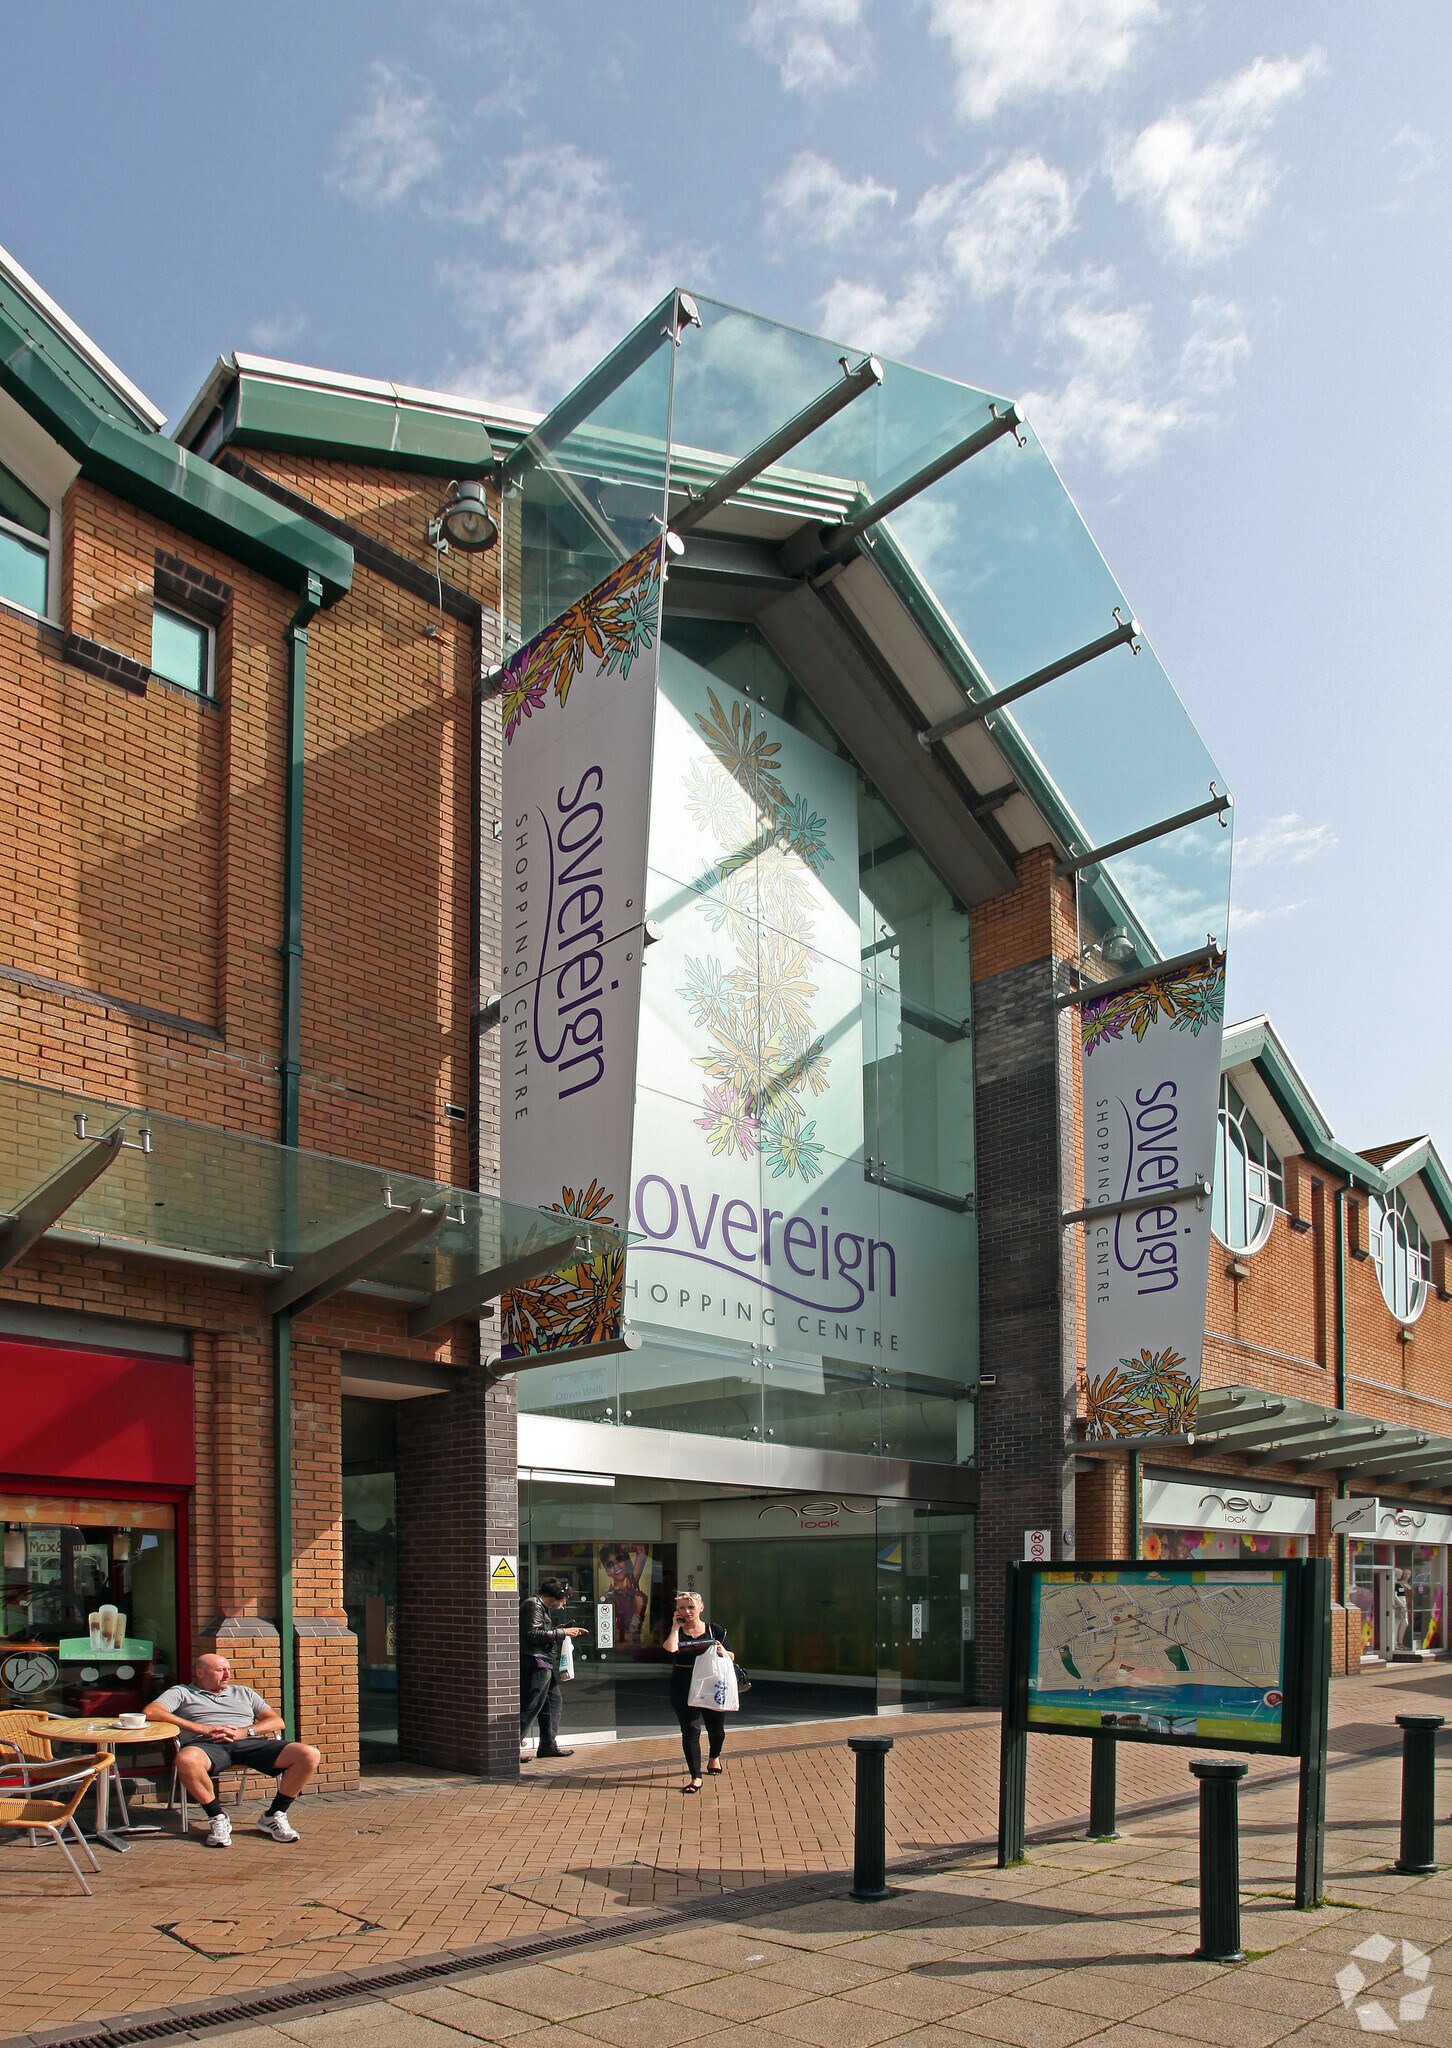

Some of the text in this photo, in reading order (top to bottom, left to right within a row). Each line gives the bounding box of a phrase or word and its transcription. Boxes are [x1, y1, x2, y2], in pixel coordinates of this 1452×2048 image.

[513, 812, 529, 1120] SHOPPING CENTRE
[534, 765, 618, 1100] sovereign
[1096, 1099, 1110, 1303] SHOPPING CENTRE
[628, 1174, 897, 1313] overeign
[625, 1279, 898, 1351] HOPPING CENTRE
[555, 1385, 604, 1401] Crown Walk
[800, 1519, 840, 1529] look
[1224, 1513, 1248, 1524] look
[1395, 1528, 1410, 1536] look
